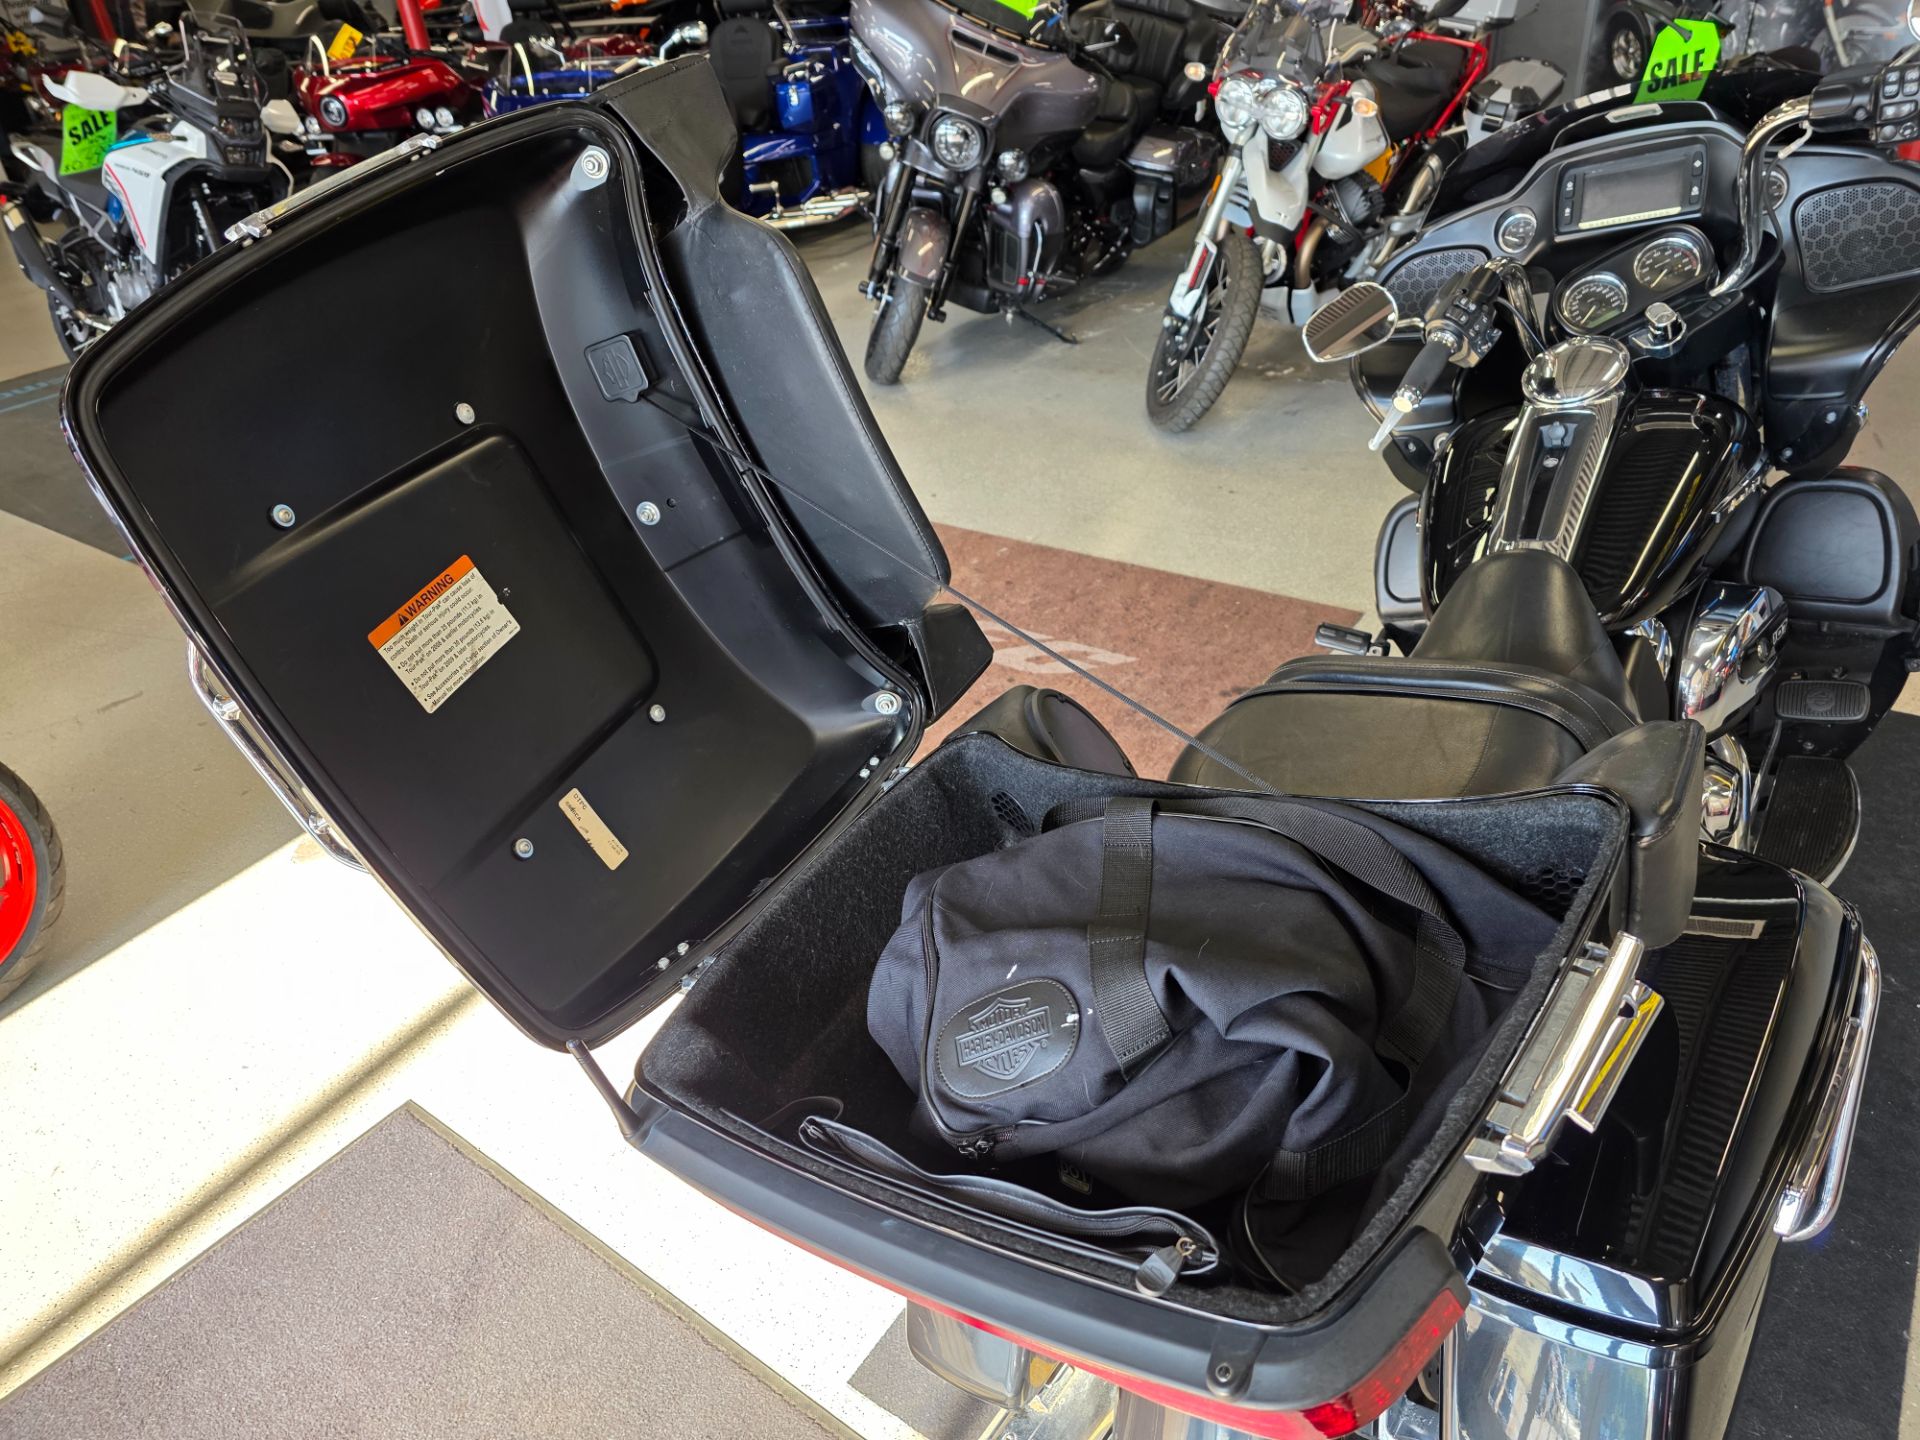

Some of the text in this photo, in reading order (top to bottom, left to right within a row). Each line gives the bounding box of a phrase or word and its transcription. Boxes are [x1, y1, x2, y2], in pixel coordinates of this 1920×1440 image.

[1647, 48, 1706, 93] SALE
[69, 111, 112, 146] SALE
[383, 643, 393, 653] Too
[391, 633, 405, 646] much
[403, 621, 420, 637] weight
[441, 595, 450, 603] can
[449, 585, 462, 597] cause
[460, 576, 471, 586] loss
[405, 573, 454, 617] WARNING
[399, 658, 408, 667] Do
[406, 652, 415, 661] not
[413, 646, 423, 656] put
[421, 637, 433, 649] more
[431, 628, 442, 639] than
[445, 610, 463, 627] pounds
[404, 633, 419, 647] Death
[421, 615, 438, 632] serious
[436, 606, 450, 619] injury
[447, 595, 461, 609] could
[425, 649, 432, 657] on
[443, 625, 458, 639] earlier
[413, 675, 421, 683] Do
[419, 669, 428, 678] not
[426, 662, 436, 672] put
[434, 653, 445, 665] more
[443, 644, 455, 655] than
[458, 626, 475, 643] pounds
[426, 689, 436, 699] See
[433, 667, 459, 692] Accessories
[457, 660, 467, 670] and
[464, 649, 479, 664] Cargo
[476, 636, 492, 652] section
[495, 618, 512, 635] Owner's
[456, 644, 467, 655] later
[431, 689, 447, 706] Manual
[445, 684, 453, 692] for
[451, 674, 464, 687] more
[962, 1016, 1047, 1056] HARLEY-DAVIDSON
[980, 1006, 1024, 1031] MOTOR
[984, 1047, 1028, 1071] CYCLES
